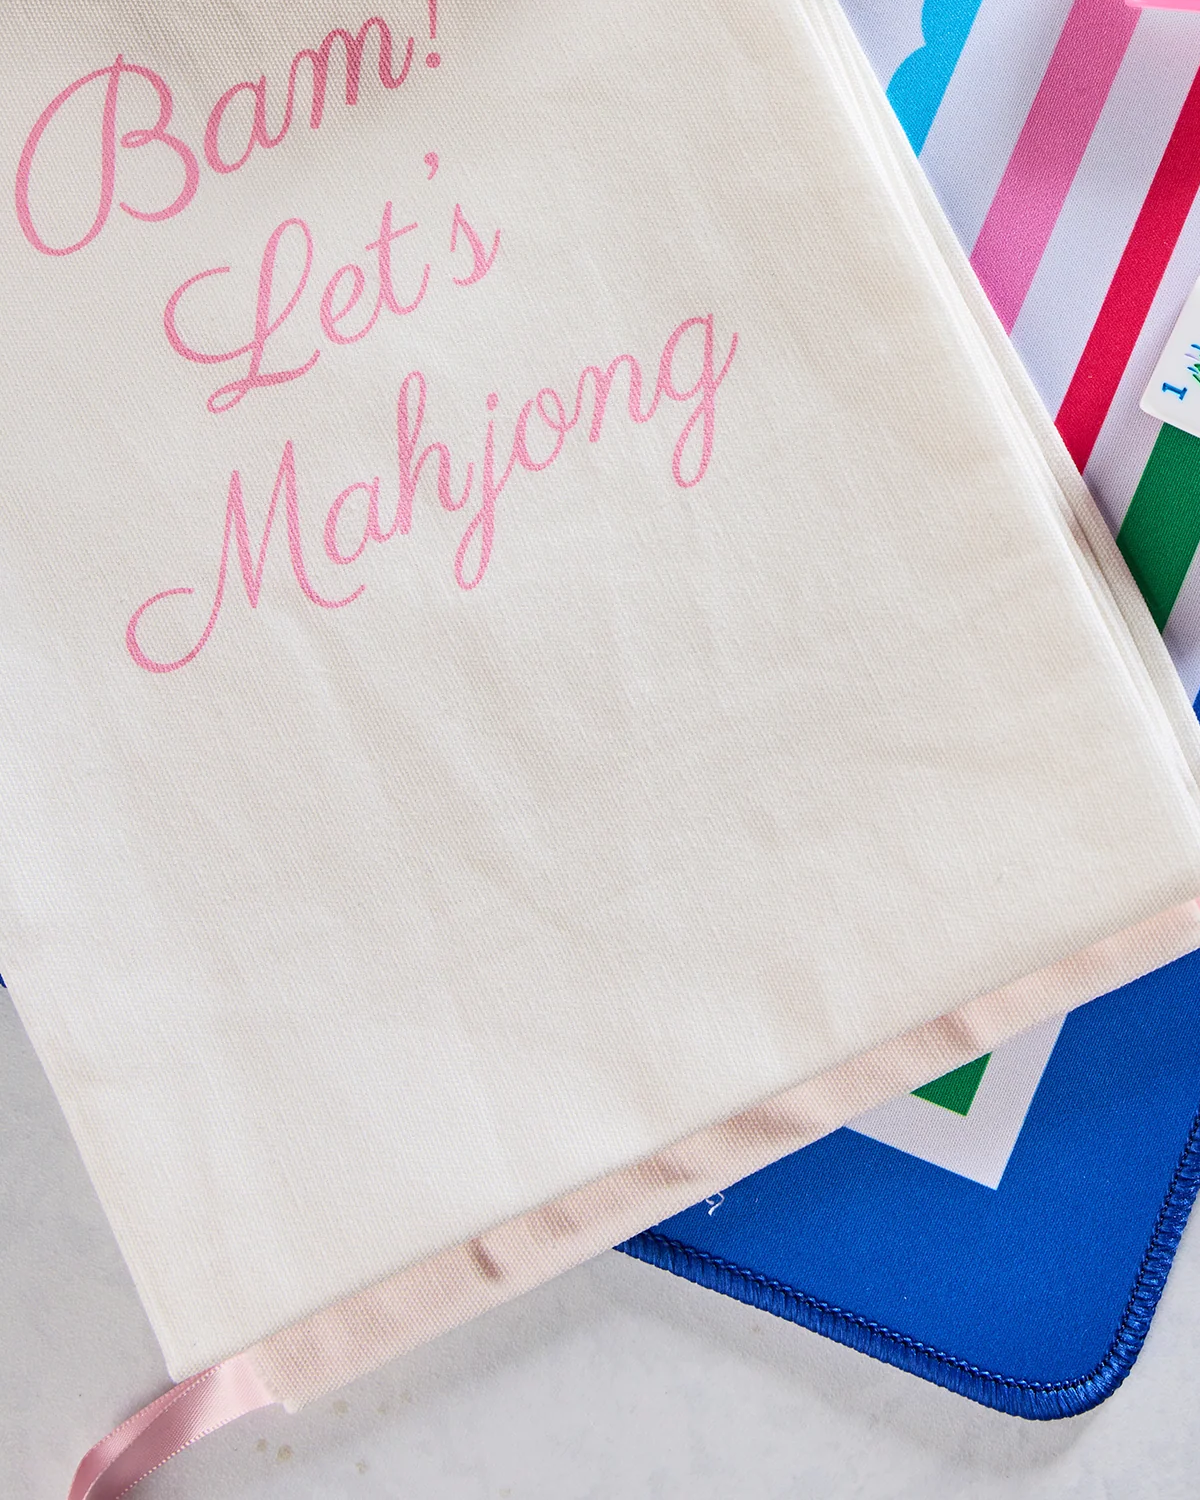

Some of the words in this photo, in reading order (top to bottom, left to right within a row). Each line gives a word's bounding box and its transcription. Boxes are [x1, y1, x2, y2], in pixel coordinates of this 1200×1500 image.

[163, 152, 501, 414] Let's
[1162, 383, 1187, 400] 1
[125, 311, 740, 674] Mahjong
